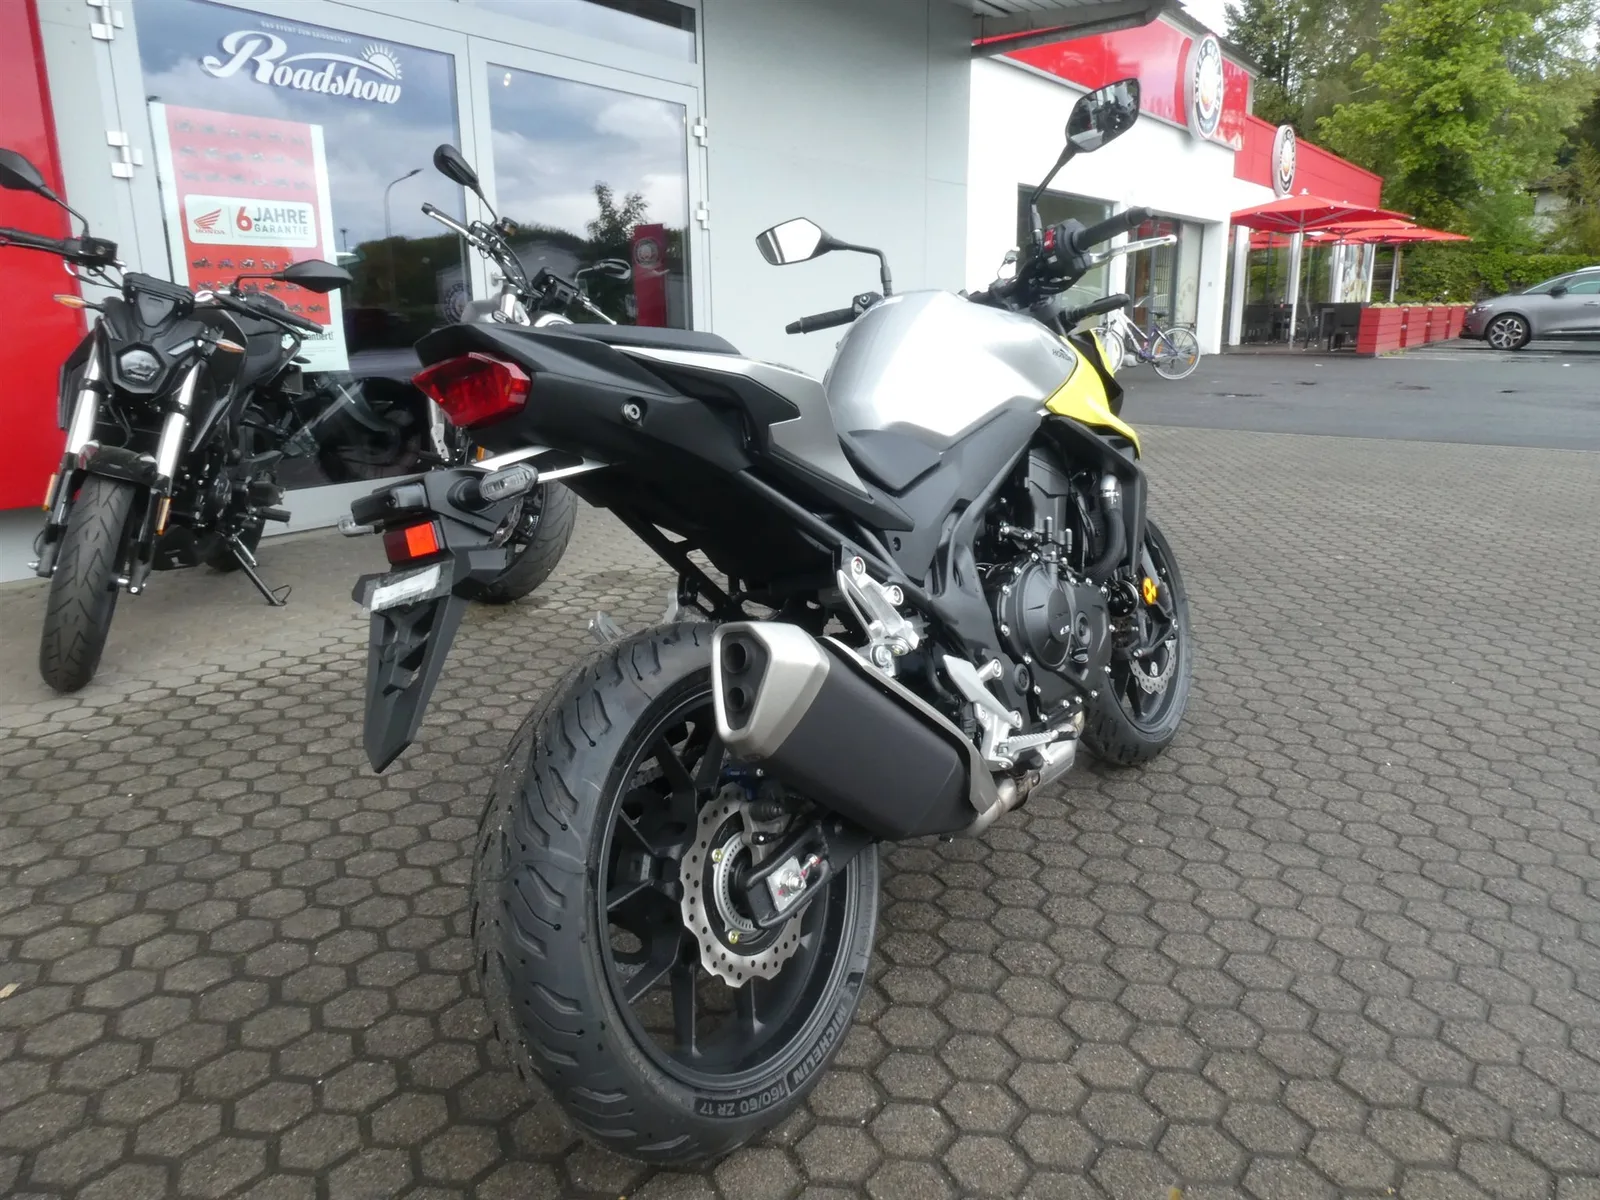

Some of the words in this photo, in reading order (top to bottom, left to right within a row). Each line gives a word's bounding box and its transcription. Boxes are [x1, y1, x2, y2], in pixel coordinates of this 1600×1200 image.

[203, 30, 401, 104] Roadshow
[236, 206, 252, 231] 6
[253, 207, 308, 225] JAHRE
[254, 223, 309, 235] GARANTIE
[792, 1004, 848, 1085] MICHELIN
[700, 1102, 715, 1115] 17
[717, 1102, 736, 1116] ZR
[740, 1083, 786, 1114] 160/60
